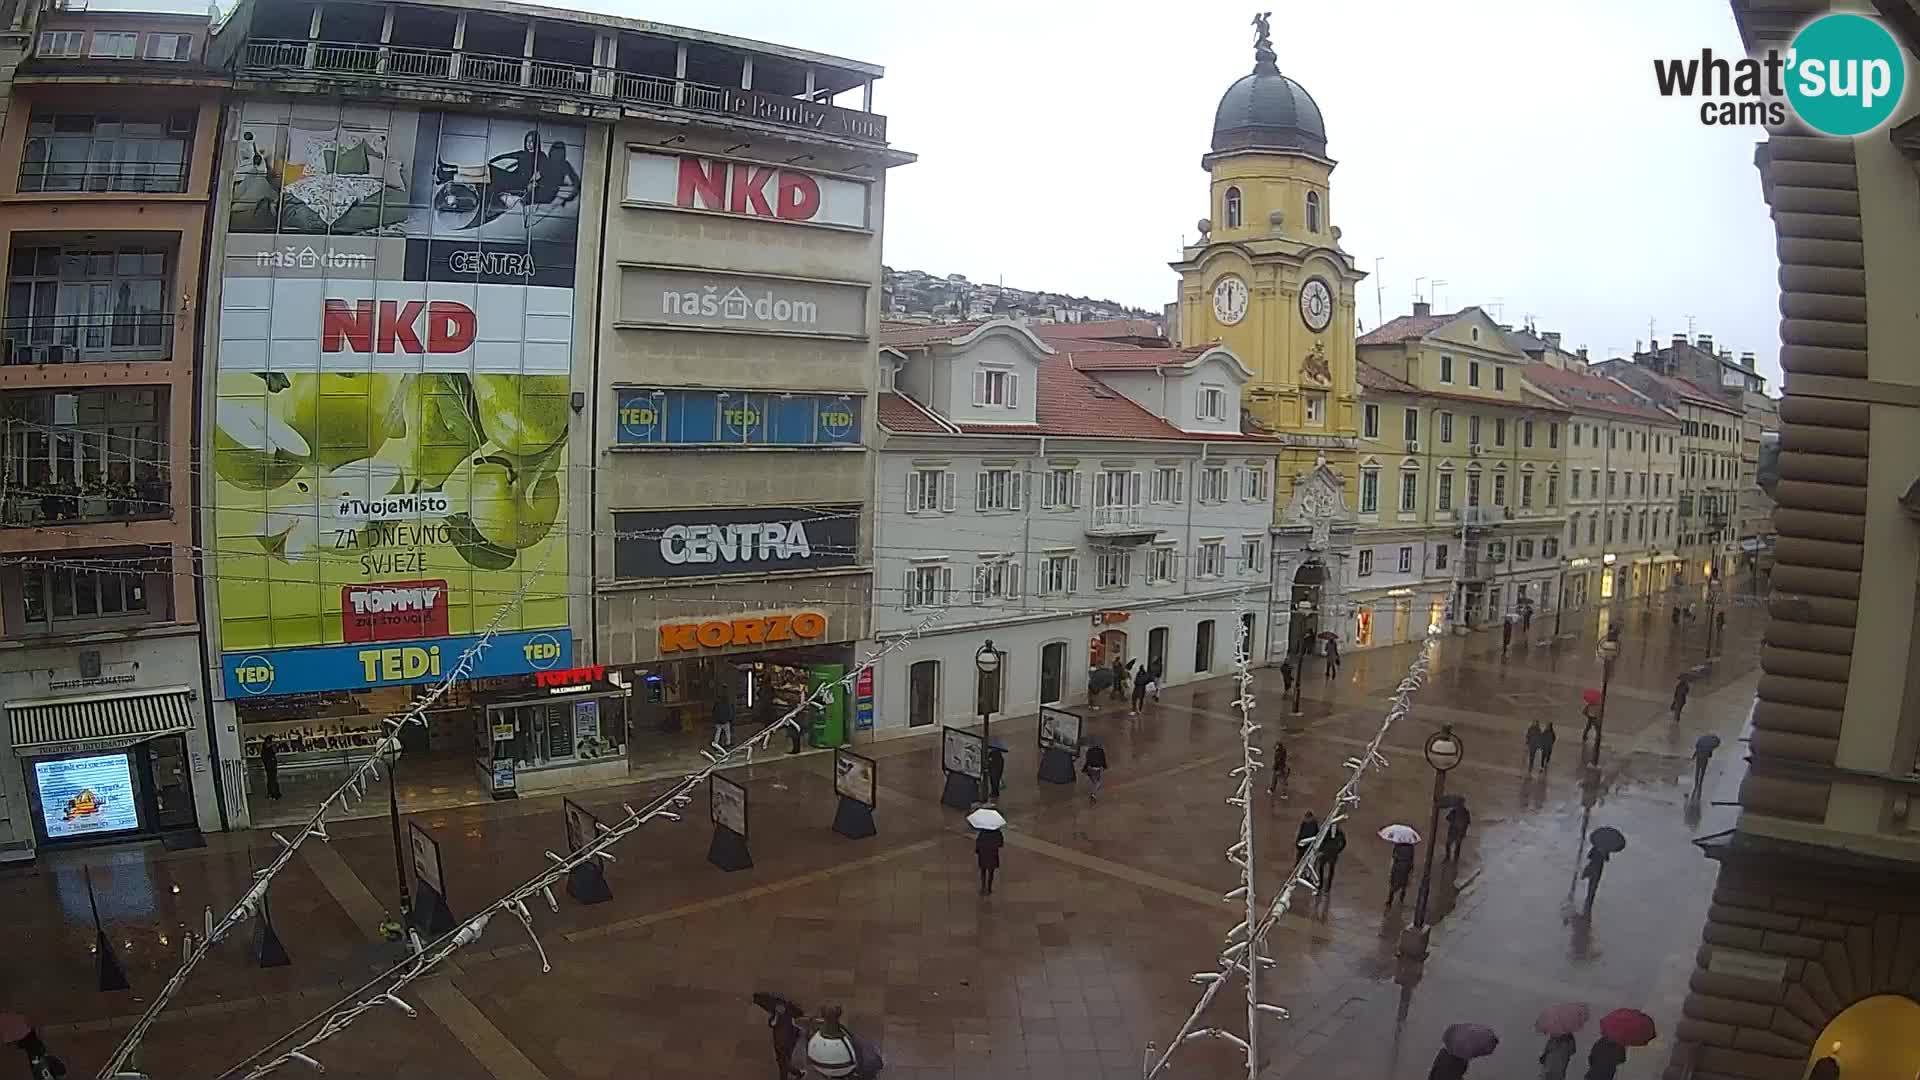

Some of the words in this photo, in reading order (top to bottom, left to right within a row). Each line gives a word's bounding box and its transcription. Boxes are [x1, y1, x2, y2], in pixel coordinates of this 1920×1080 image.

[676, 158, 821, 222] NKD
[256, 245, 296, 268] naš
[321, 247, 367, 268] dom
[449, 251, 536, 276] CENTRA
[662, 285, 717, 316] naš
[754, 291, 817, 324] dom
[321, 298, 478, 353] NKD
[619, 407, 658, 425] TEDi
[724, 409, 760, 426] TEDi
[820, 411, 853, 427] TEDi
[339, 496, 447, 516] #TvojeMisto
[335, 528, 360, 549] ZA
[367, 524, 451, 547] DNEVNO
[660, 520, 811, 565] CENTRA
[360, 547, 428, 575] SVJEŽE
[350, 587, 440, 614] TOMMY
[659, 612, 826, 653] KORZO
[359, 645, 441, 682] TEDi
[523, 642, 561, 661] TEDi
[235, 665, 275, 684] TEDi
[535, 664, 605, 687] TOMMY
